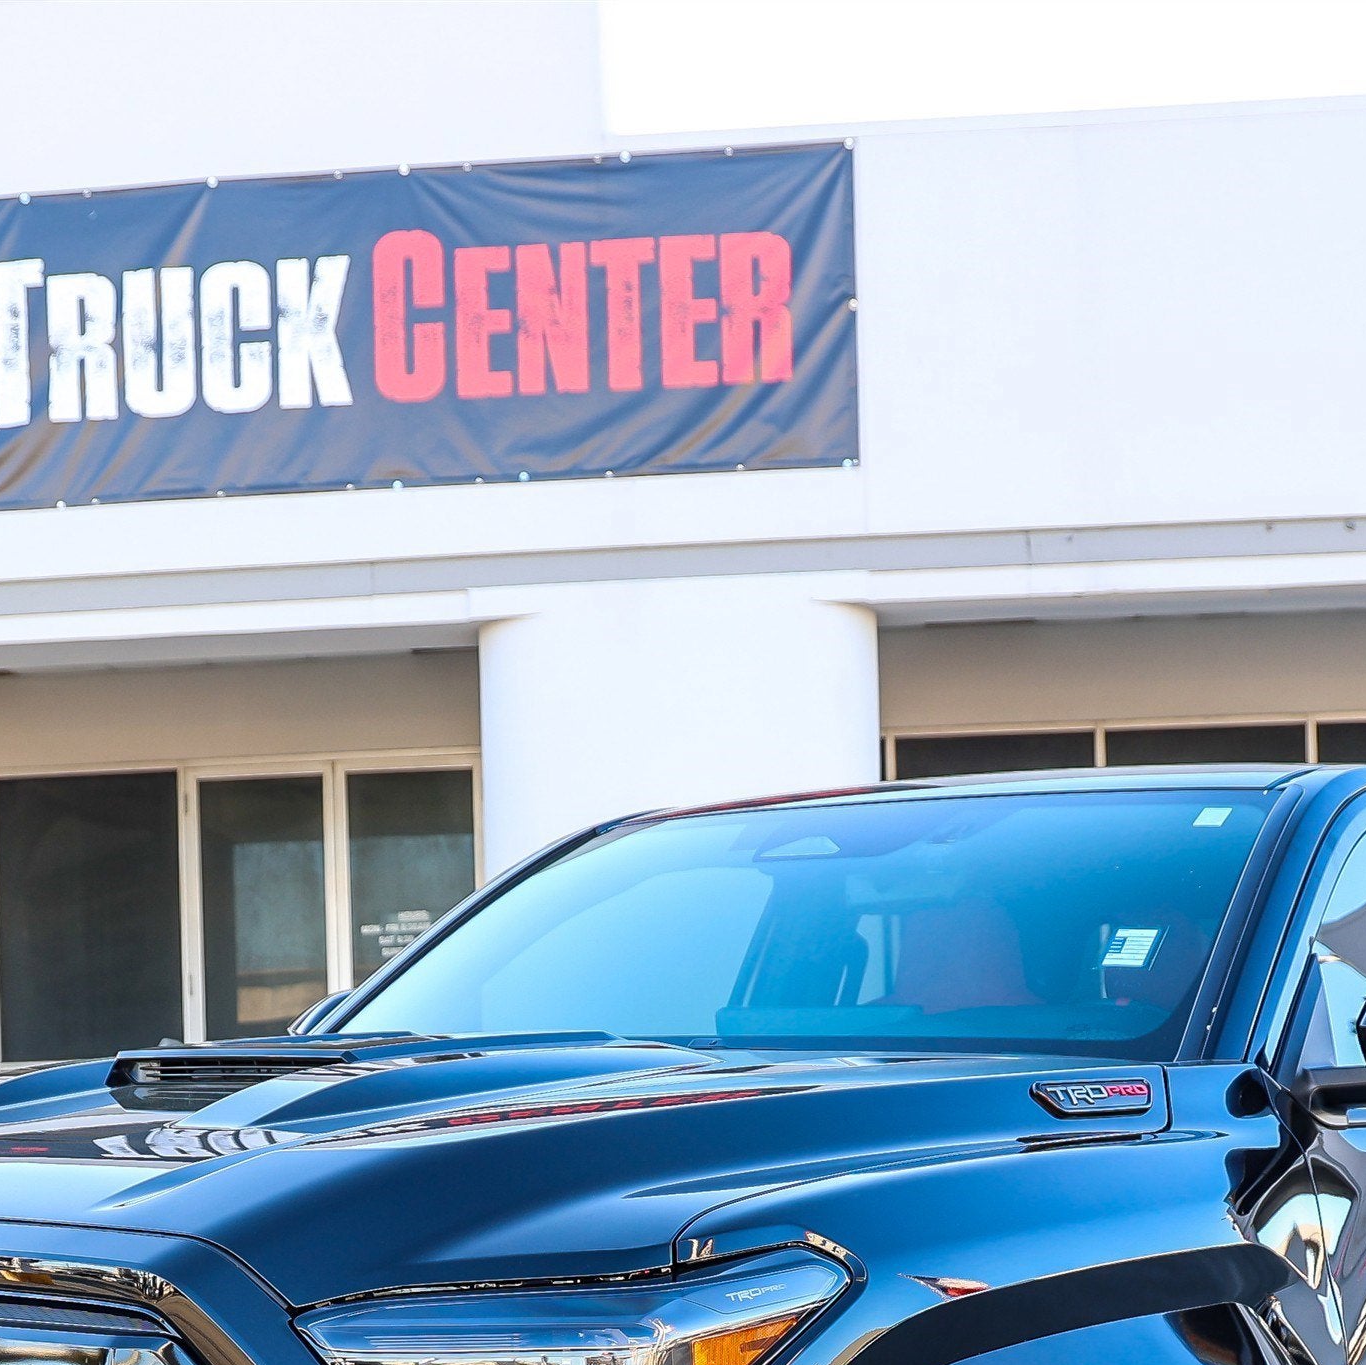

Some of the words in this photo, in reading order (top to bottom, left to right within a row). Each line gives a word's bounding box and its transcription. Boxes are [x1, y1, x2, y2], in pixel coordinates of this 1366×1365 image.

[372, 229, 794, 403] CENTER
[1047, 1085, 1108, 1105] TRD
[1107, 1084, 1148, 1098] PRO
[725, 1287, 762, 1302] TRD
[761, 1283, 787, 1294] PRO
